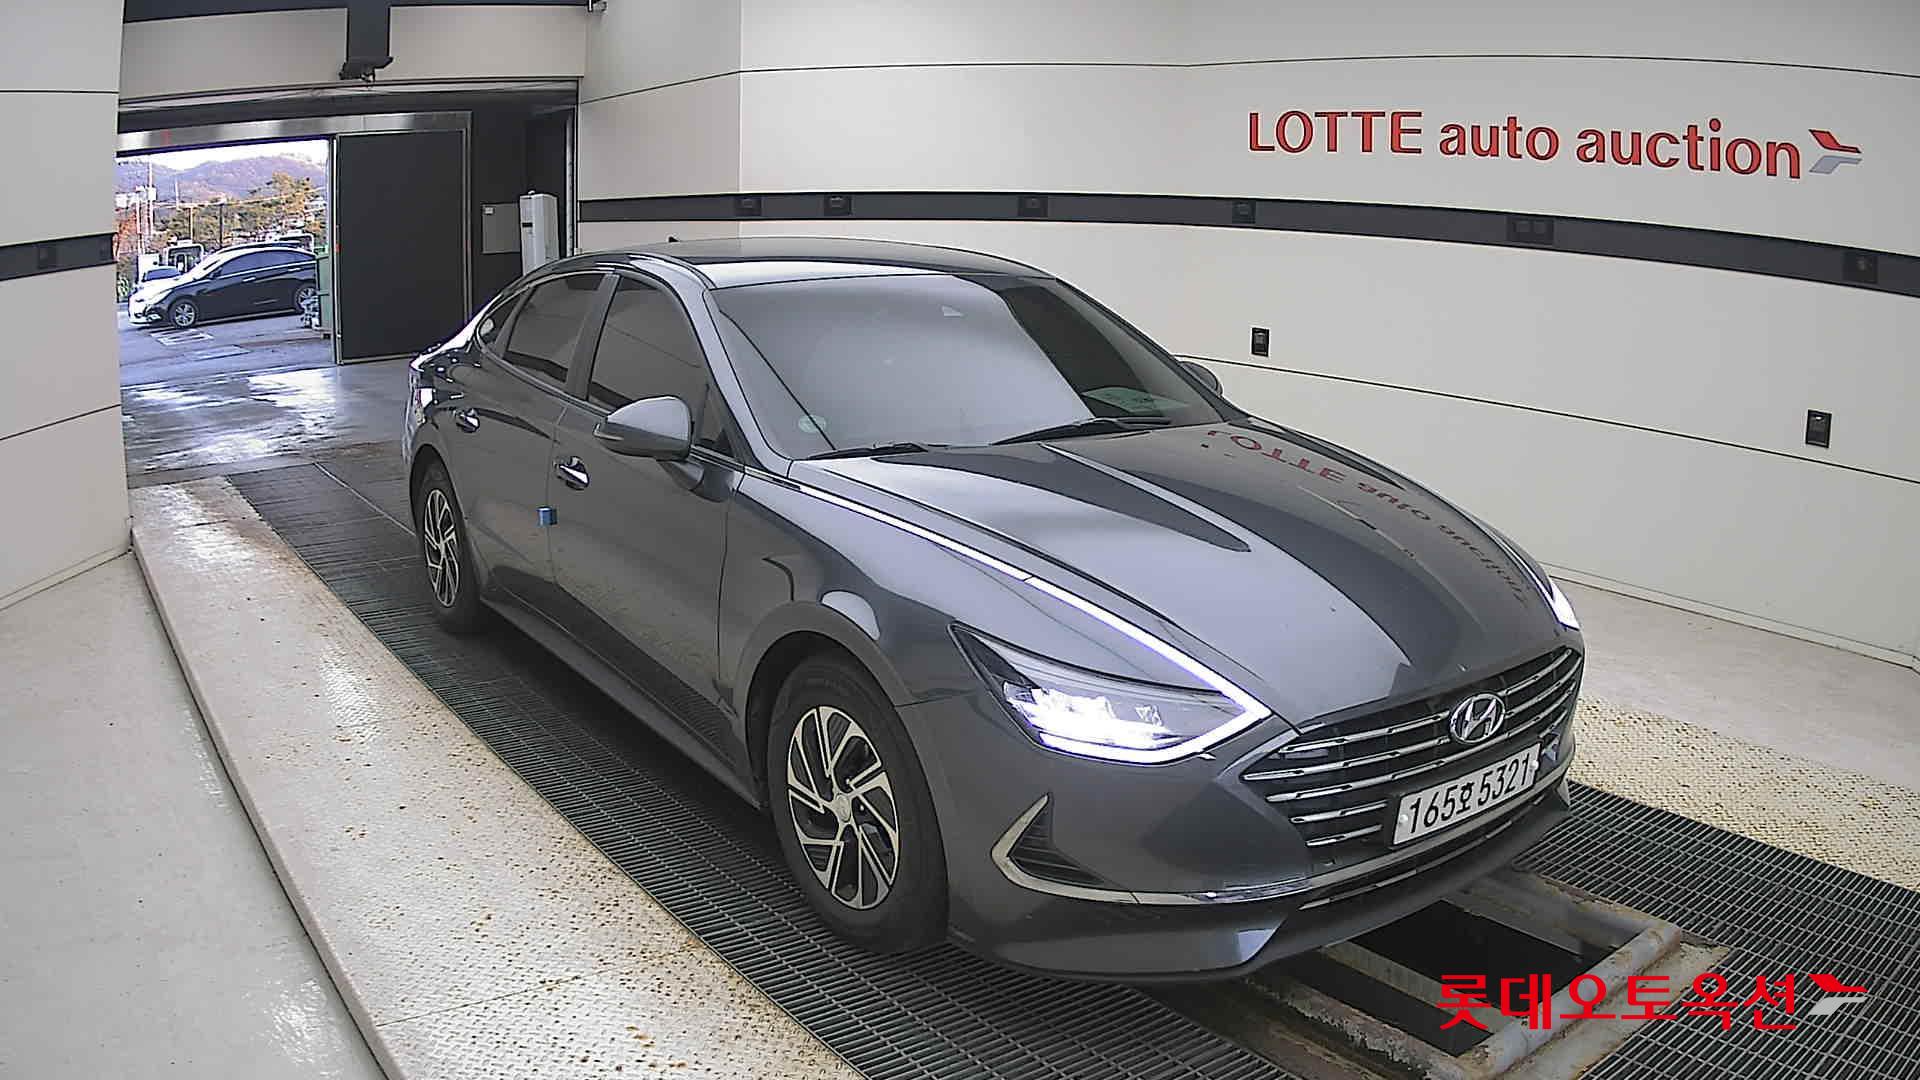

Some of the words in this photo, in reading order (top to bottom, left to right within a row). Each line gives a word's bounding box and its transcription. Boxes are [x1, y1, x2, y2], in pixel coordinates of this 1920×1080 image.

[1248, 110, 1423, 155] LOTTE
[1439, 115, 1560, 161] auto
[1575, 117, 1802, 180] auction
[1409, 781, 1475, 834] 165호
[1477, 753, 1531, 807] 5321
